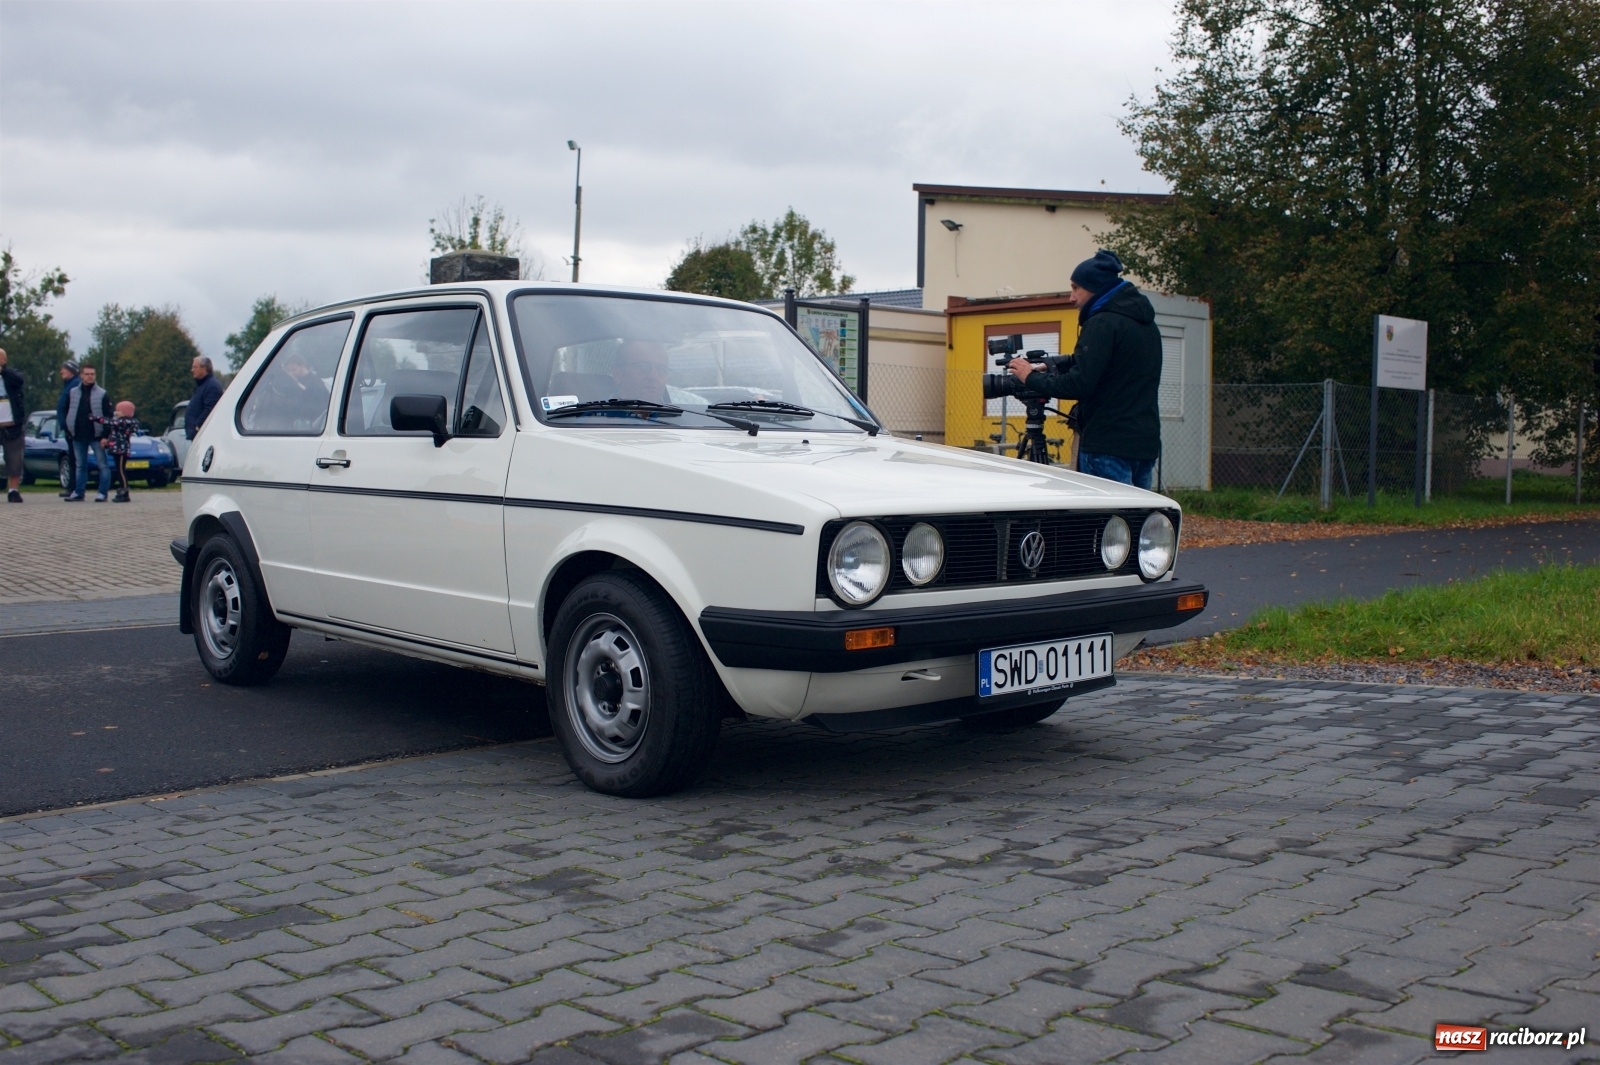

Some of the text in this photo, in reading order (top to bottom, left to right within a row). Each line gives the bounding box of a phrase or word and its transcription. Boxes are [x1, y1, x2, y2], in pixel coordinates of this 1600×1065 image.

[994, 638, 1107, 689] SWD 01111
[980, 678, 990, 688] PL
